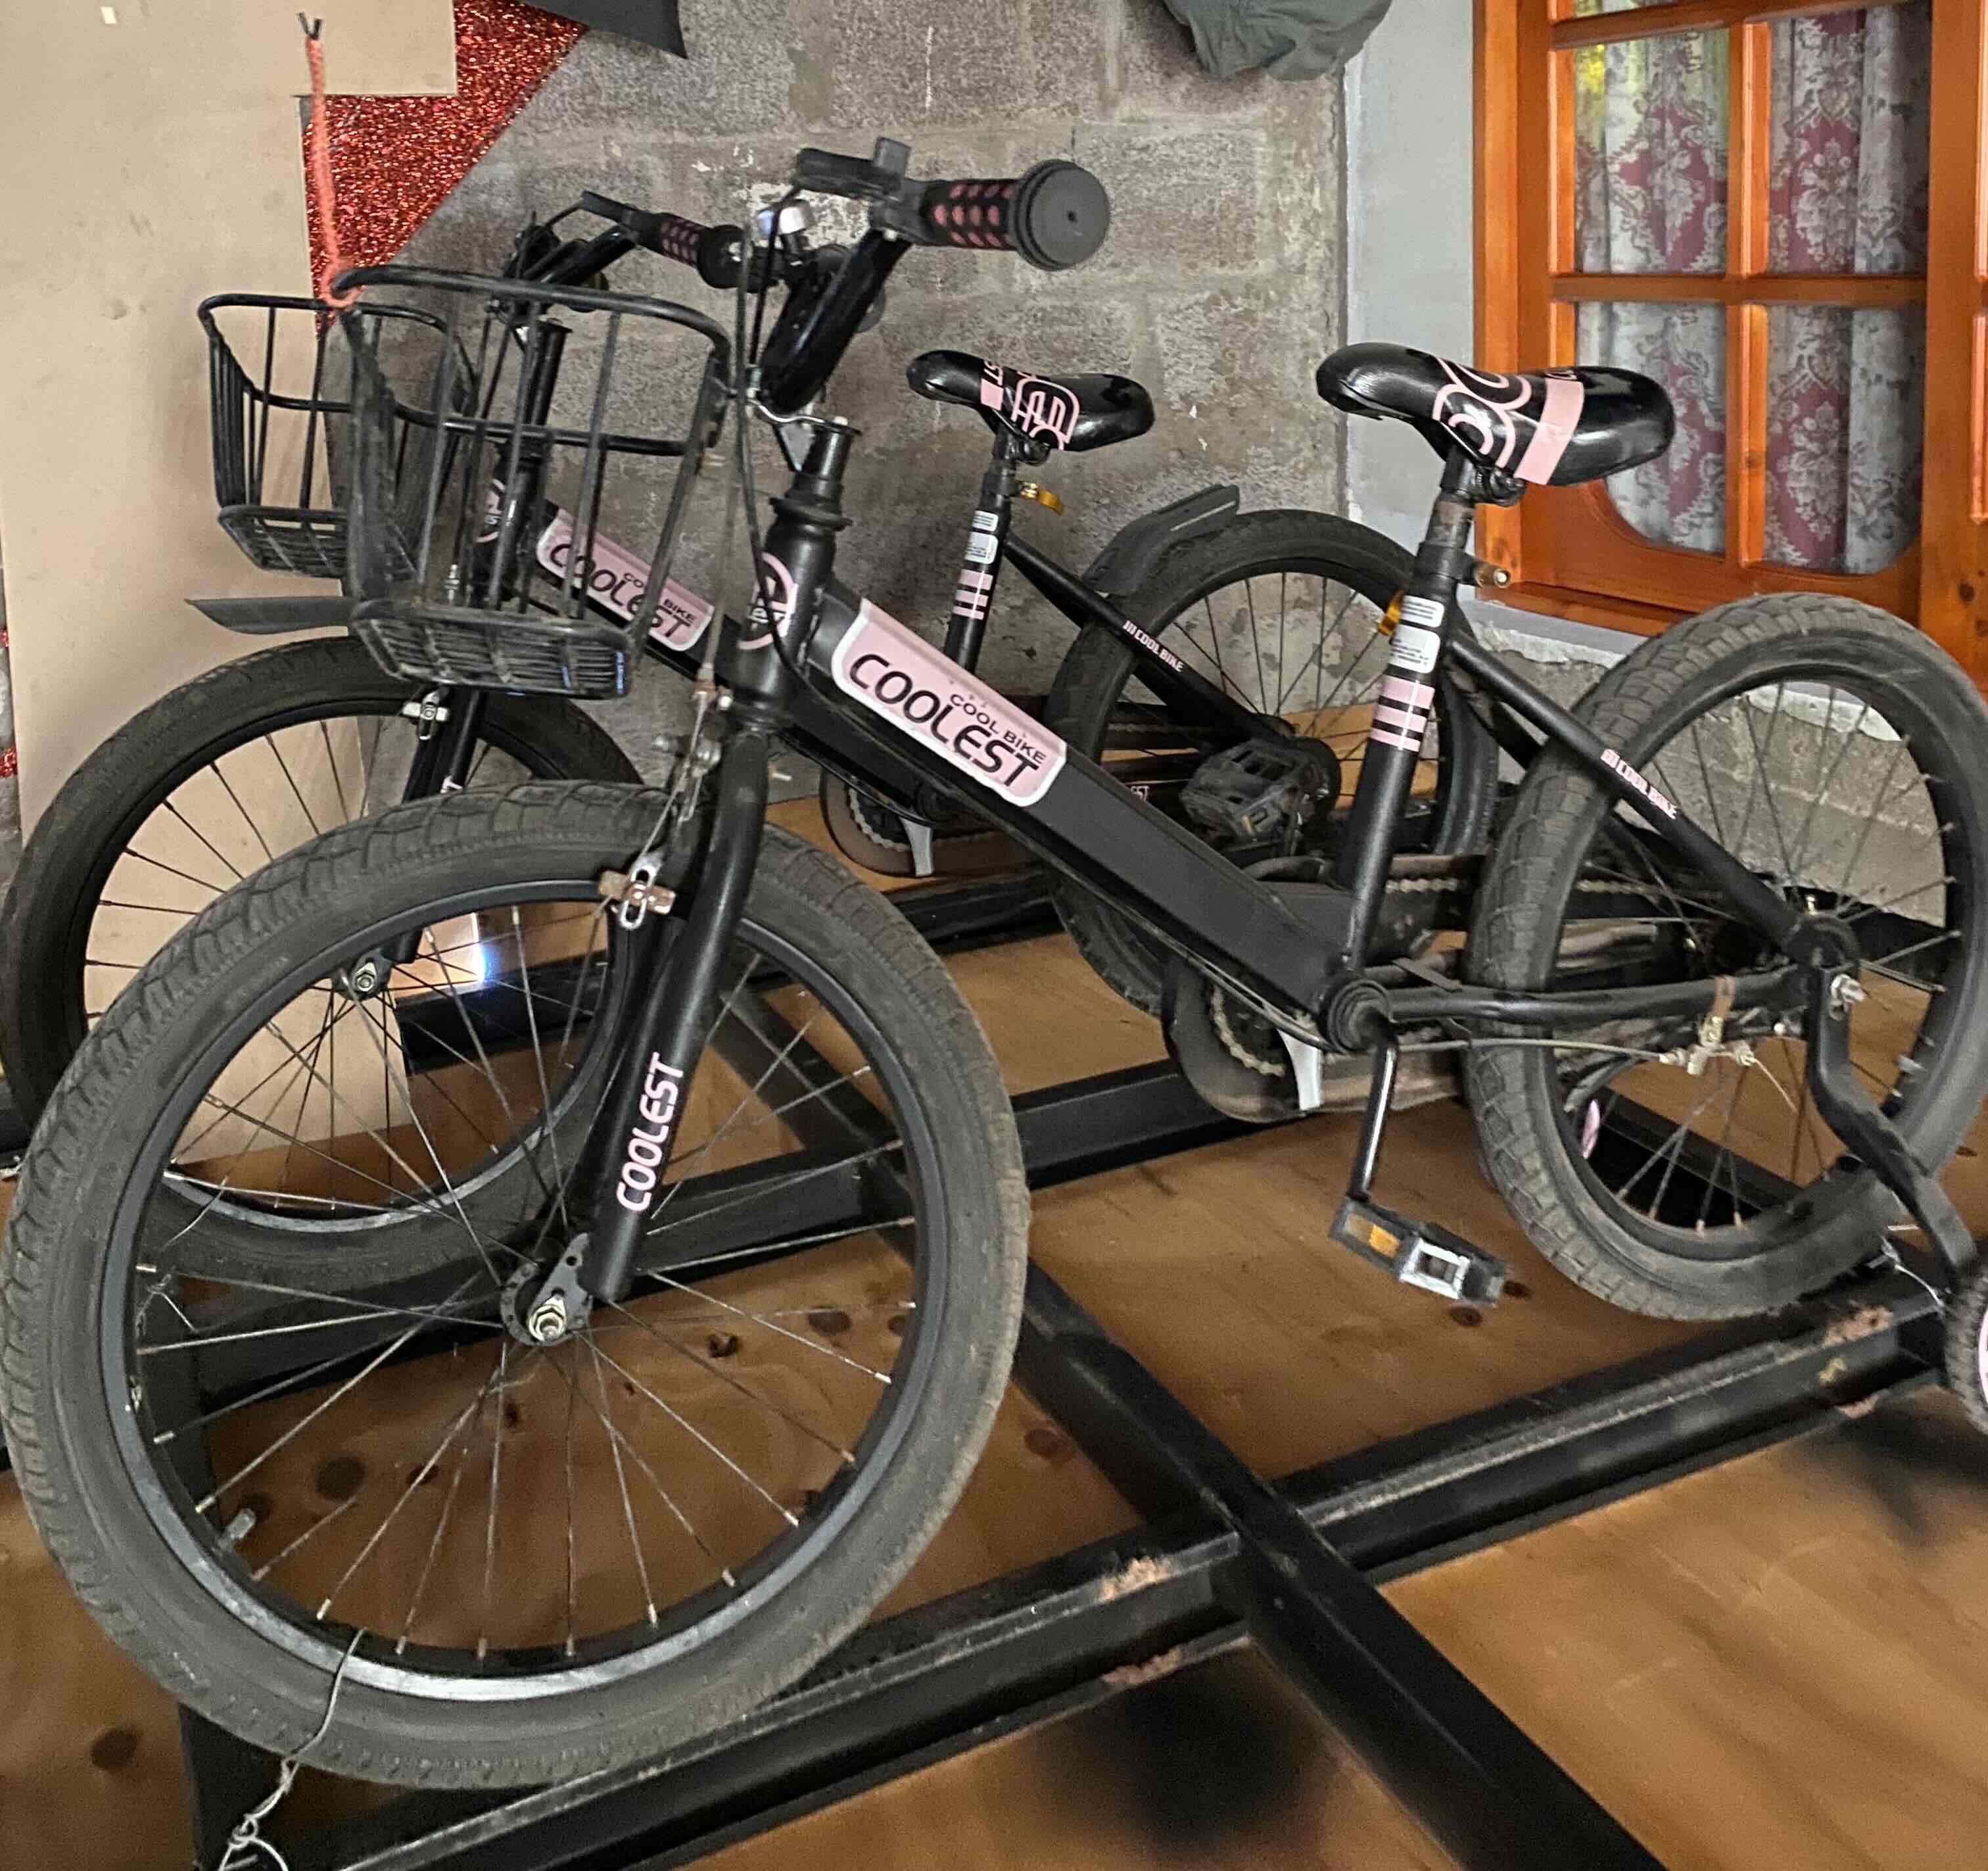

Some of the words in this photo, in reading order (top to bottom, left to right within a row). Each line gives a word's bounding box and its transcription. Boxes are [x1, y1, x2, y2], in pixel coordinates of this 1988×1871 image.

[663, 599, 696, 623] BIKE
[849, 654, 1039, 787] COOLEST
[950, 694, 999, 734] COOL
[1003, 730, 1047, 765] BIKE
[616, 1051, 684, 1212] COOLEST
